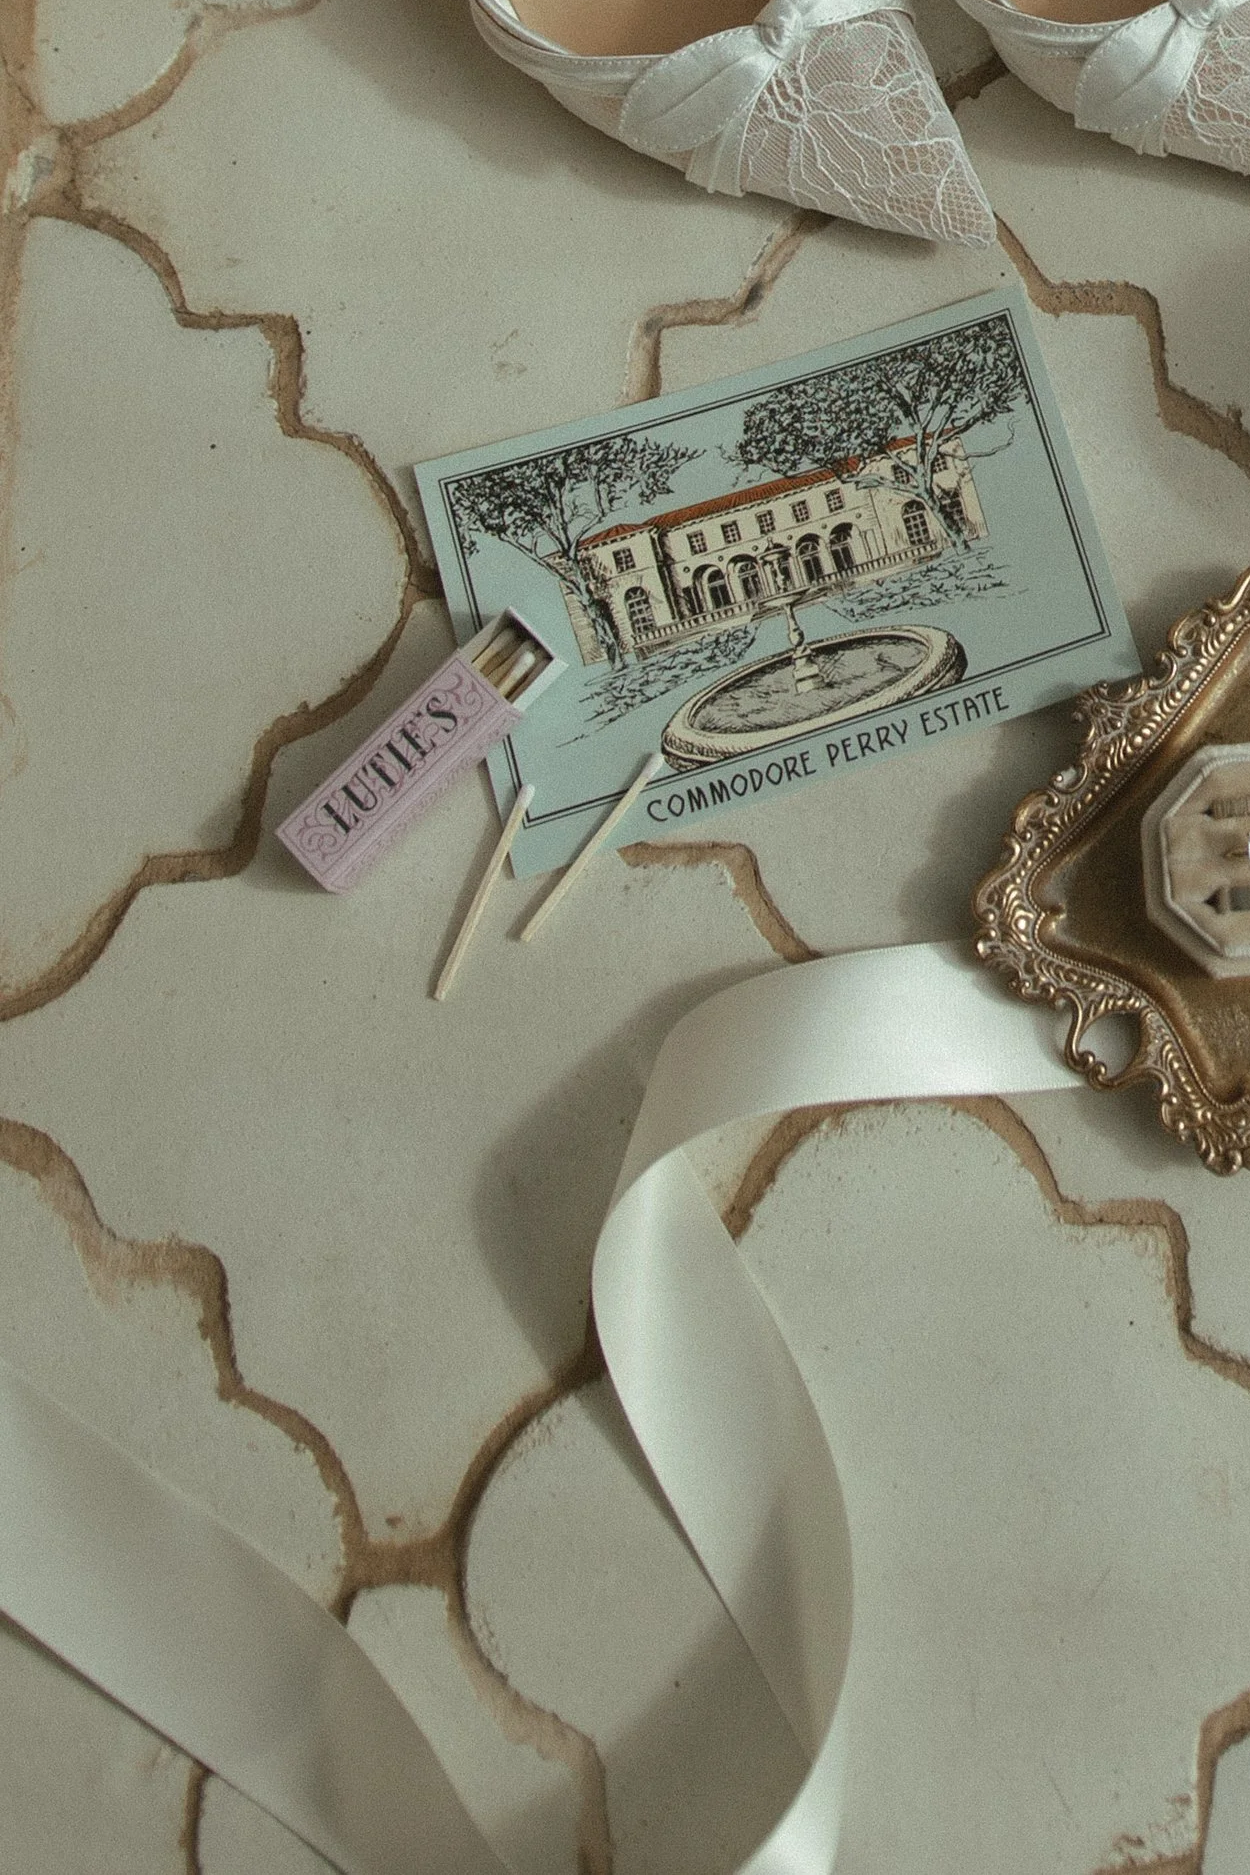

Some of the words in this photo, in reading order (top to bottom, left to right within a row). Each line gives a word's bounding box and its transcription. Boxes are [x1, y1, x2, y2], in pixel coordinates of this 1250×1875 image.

[646, 750, 817, 823] COMMODORE
[825, 718, 908, 768] PERRY
[919, 686, 1010, 737] ESTATE
